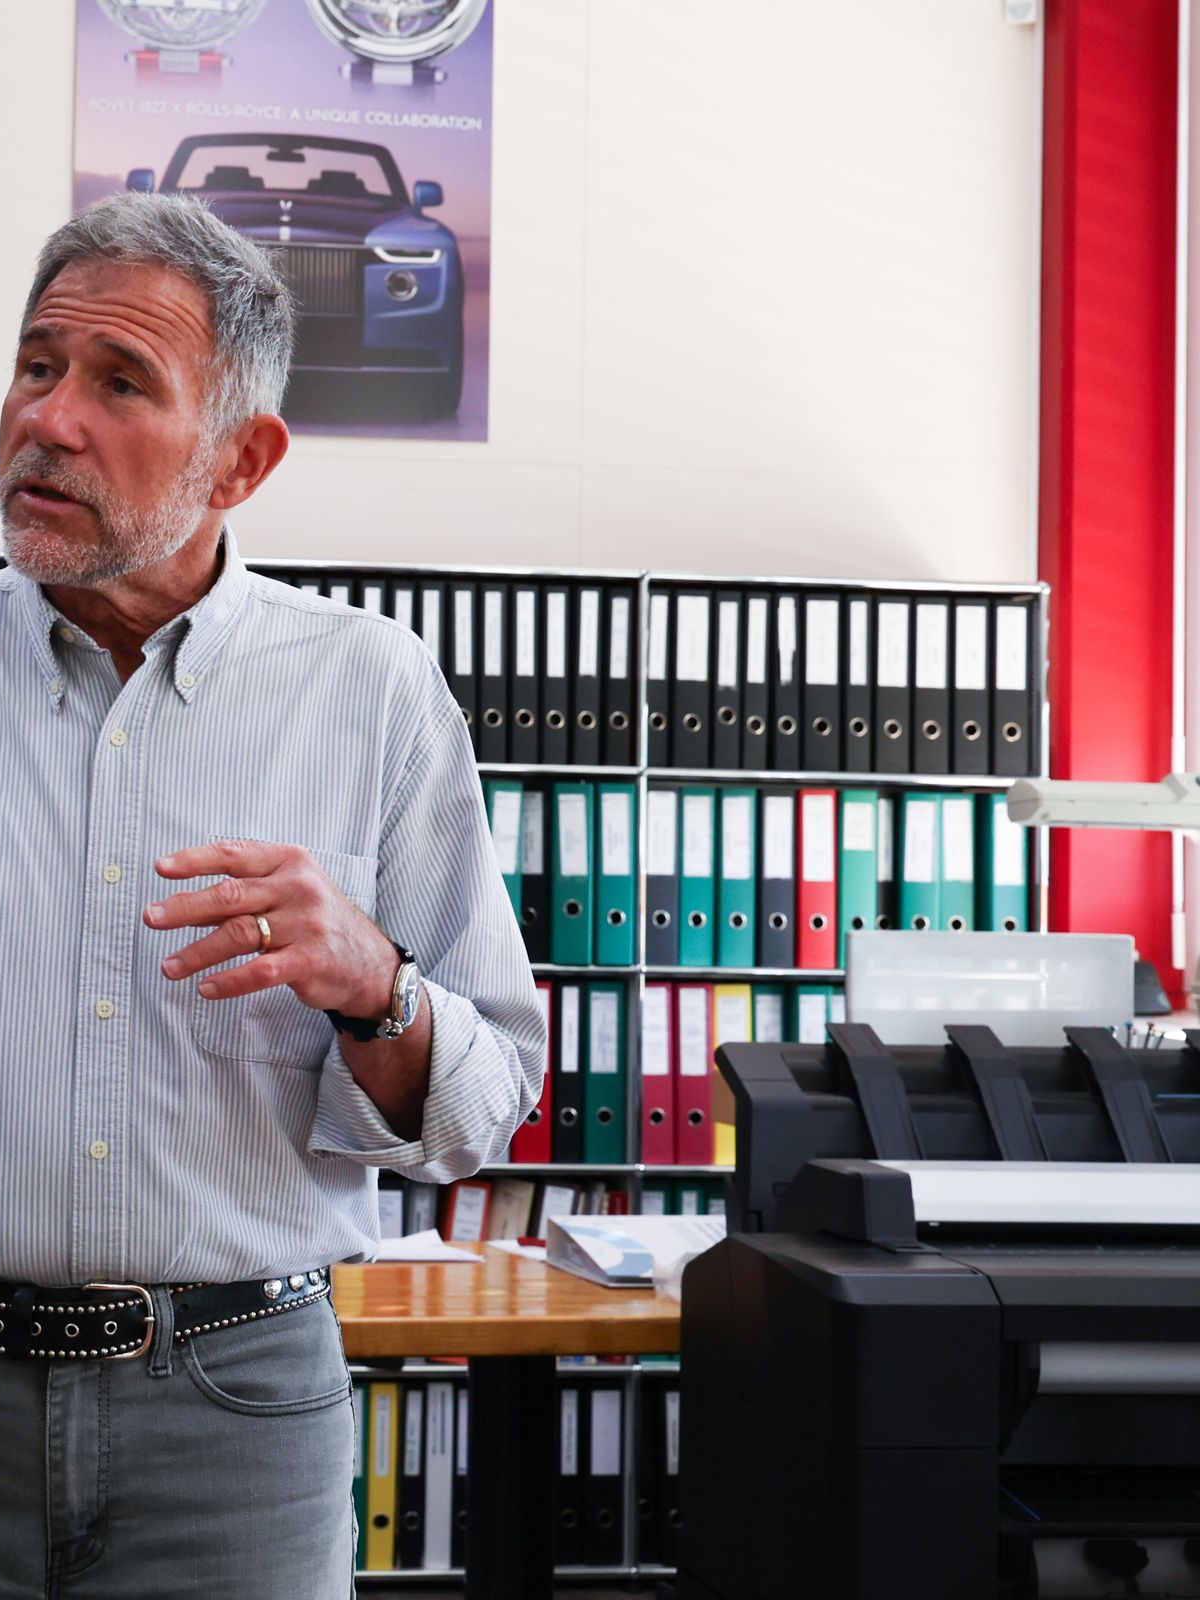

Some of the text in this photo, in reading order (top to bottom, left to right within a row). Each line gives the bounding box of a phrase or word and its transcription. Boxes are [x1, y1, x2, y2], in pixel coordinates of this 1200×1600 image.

[87, 97, 134, 112] BOVET
[289, 108, 301, 121] A
[304, 108, 361, 125] UNIQUE
[364, 110, 483, 131] COLLABORATION
